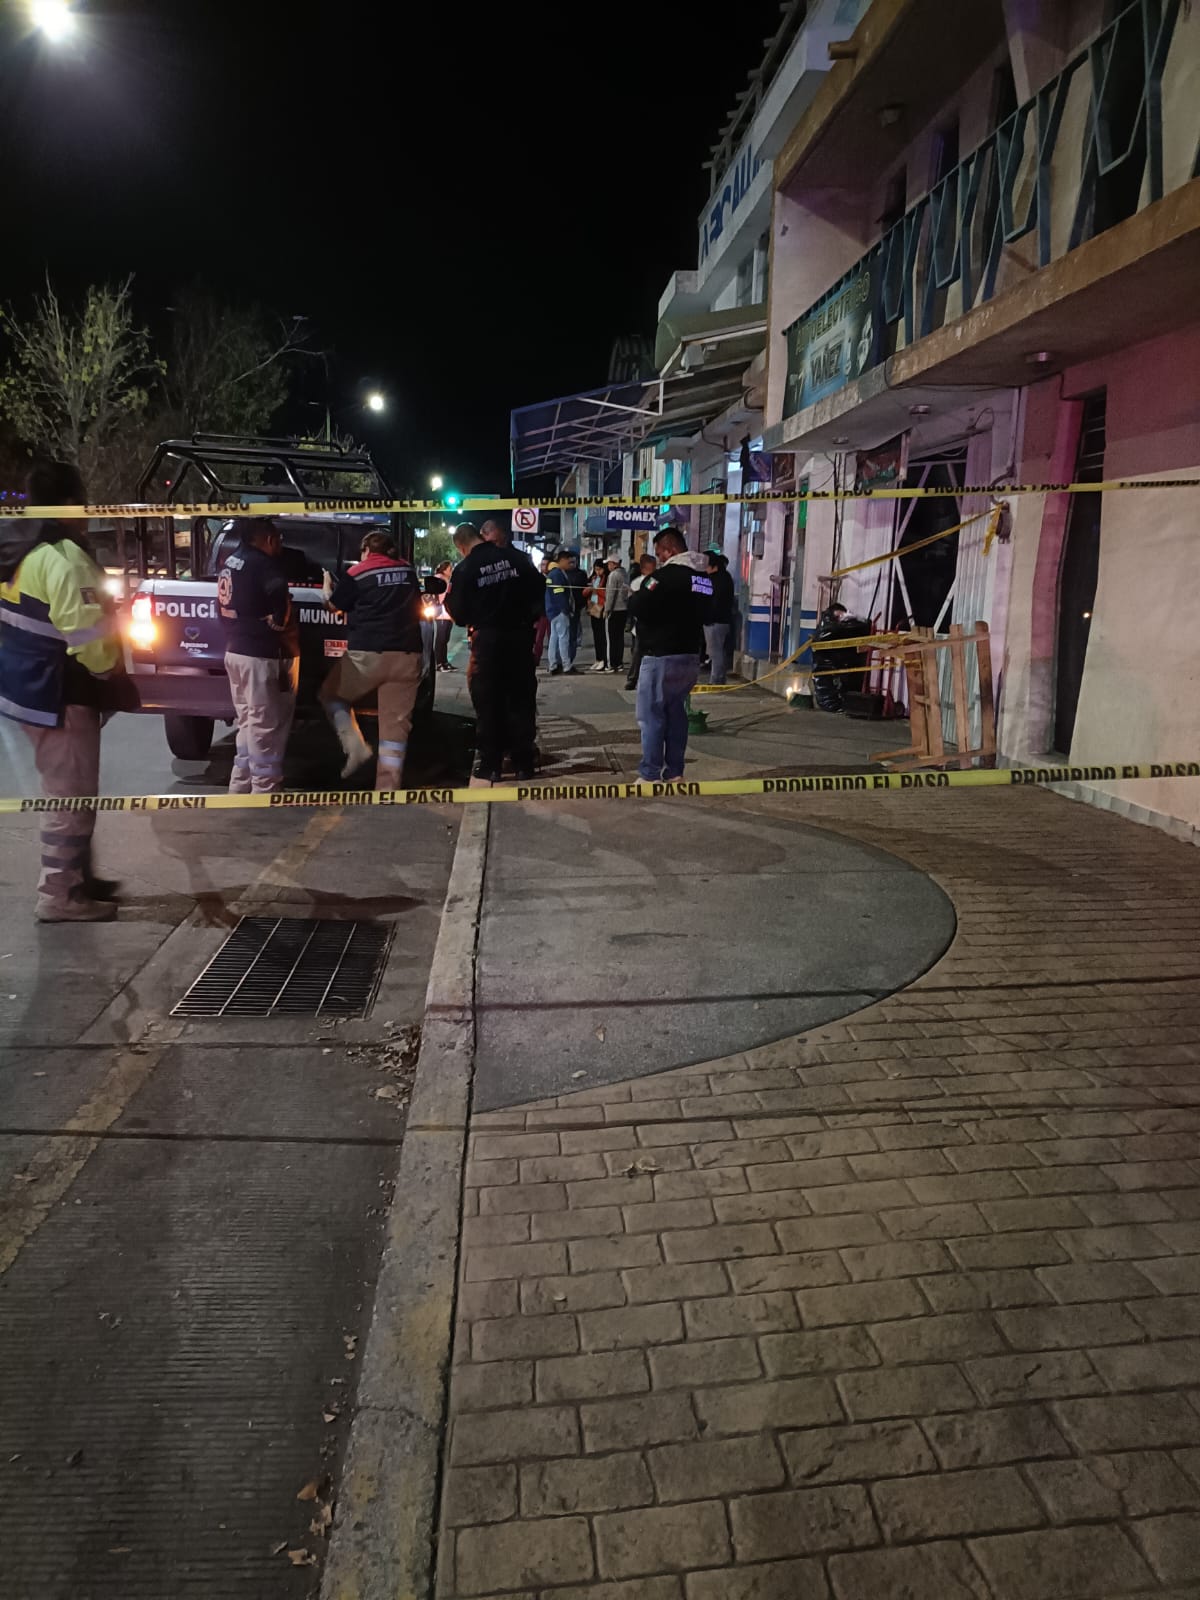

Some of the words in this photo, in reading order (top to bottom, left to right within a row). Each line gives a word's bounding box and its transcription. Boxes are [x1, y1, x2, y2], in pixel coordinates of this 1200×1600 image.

[607, 510, 657, 523] PROMEX
[155, 599, 218, 619] POLICÍ
[299, 607, 347, 625] MUNICI
[763, 776, 867, 792] PROHIBIDO
[873, 775, 889, 789] EL
[900, 773, 950, 788] PASO
[1011, 767, 1116, 785] PROHIBIDO
[1121, 765, 1139, 778] EL
[1150, 762, 1200, 778] PASO
[270, 791, 373, 806] PROHIBIDO
[379, 791, 395, 805] EL
[405, 789, 454, 805] PASO
[518, 785, 620, 801] PROHIBIDO
[626, 784, 642, 798] EL
[652, 782, 701, 797] PASO
[20, 798, 125, 812] PROHIBIDO
[130, 797, 147, 811] EL
[157, 796, 206, 811] PASO
